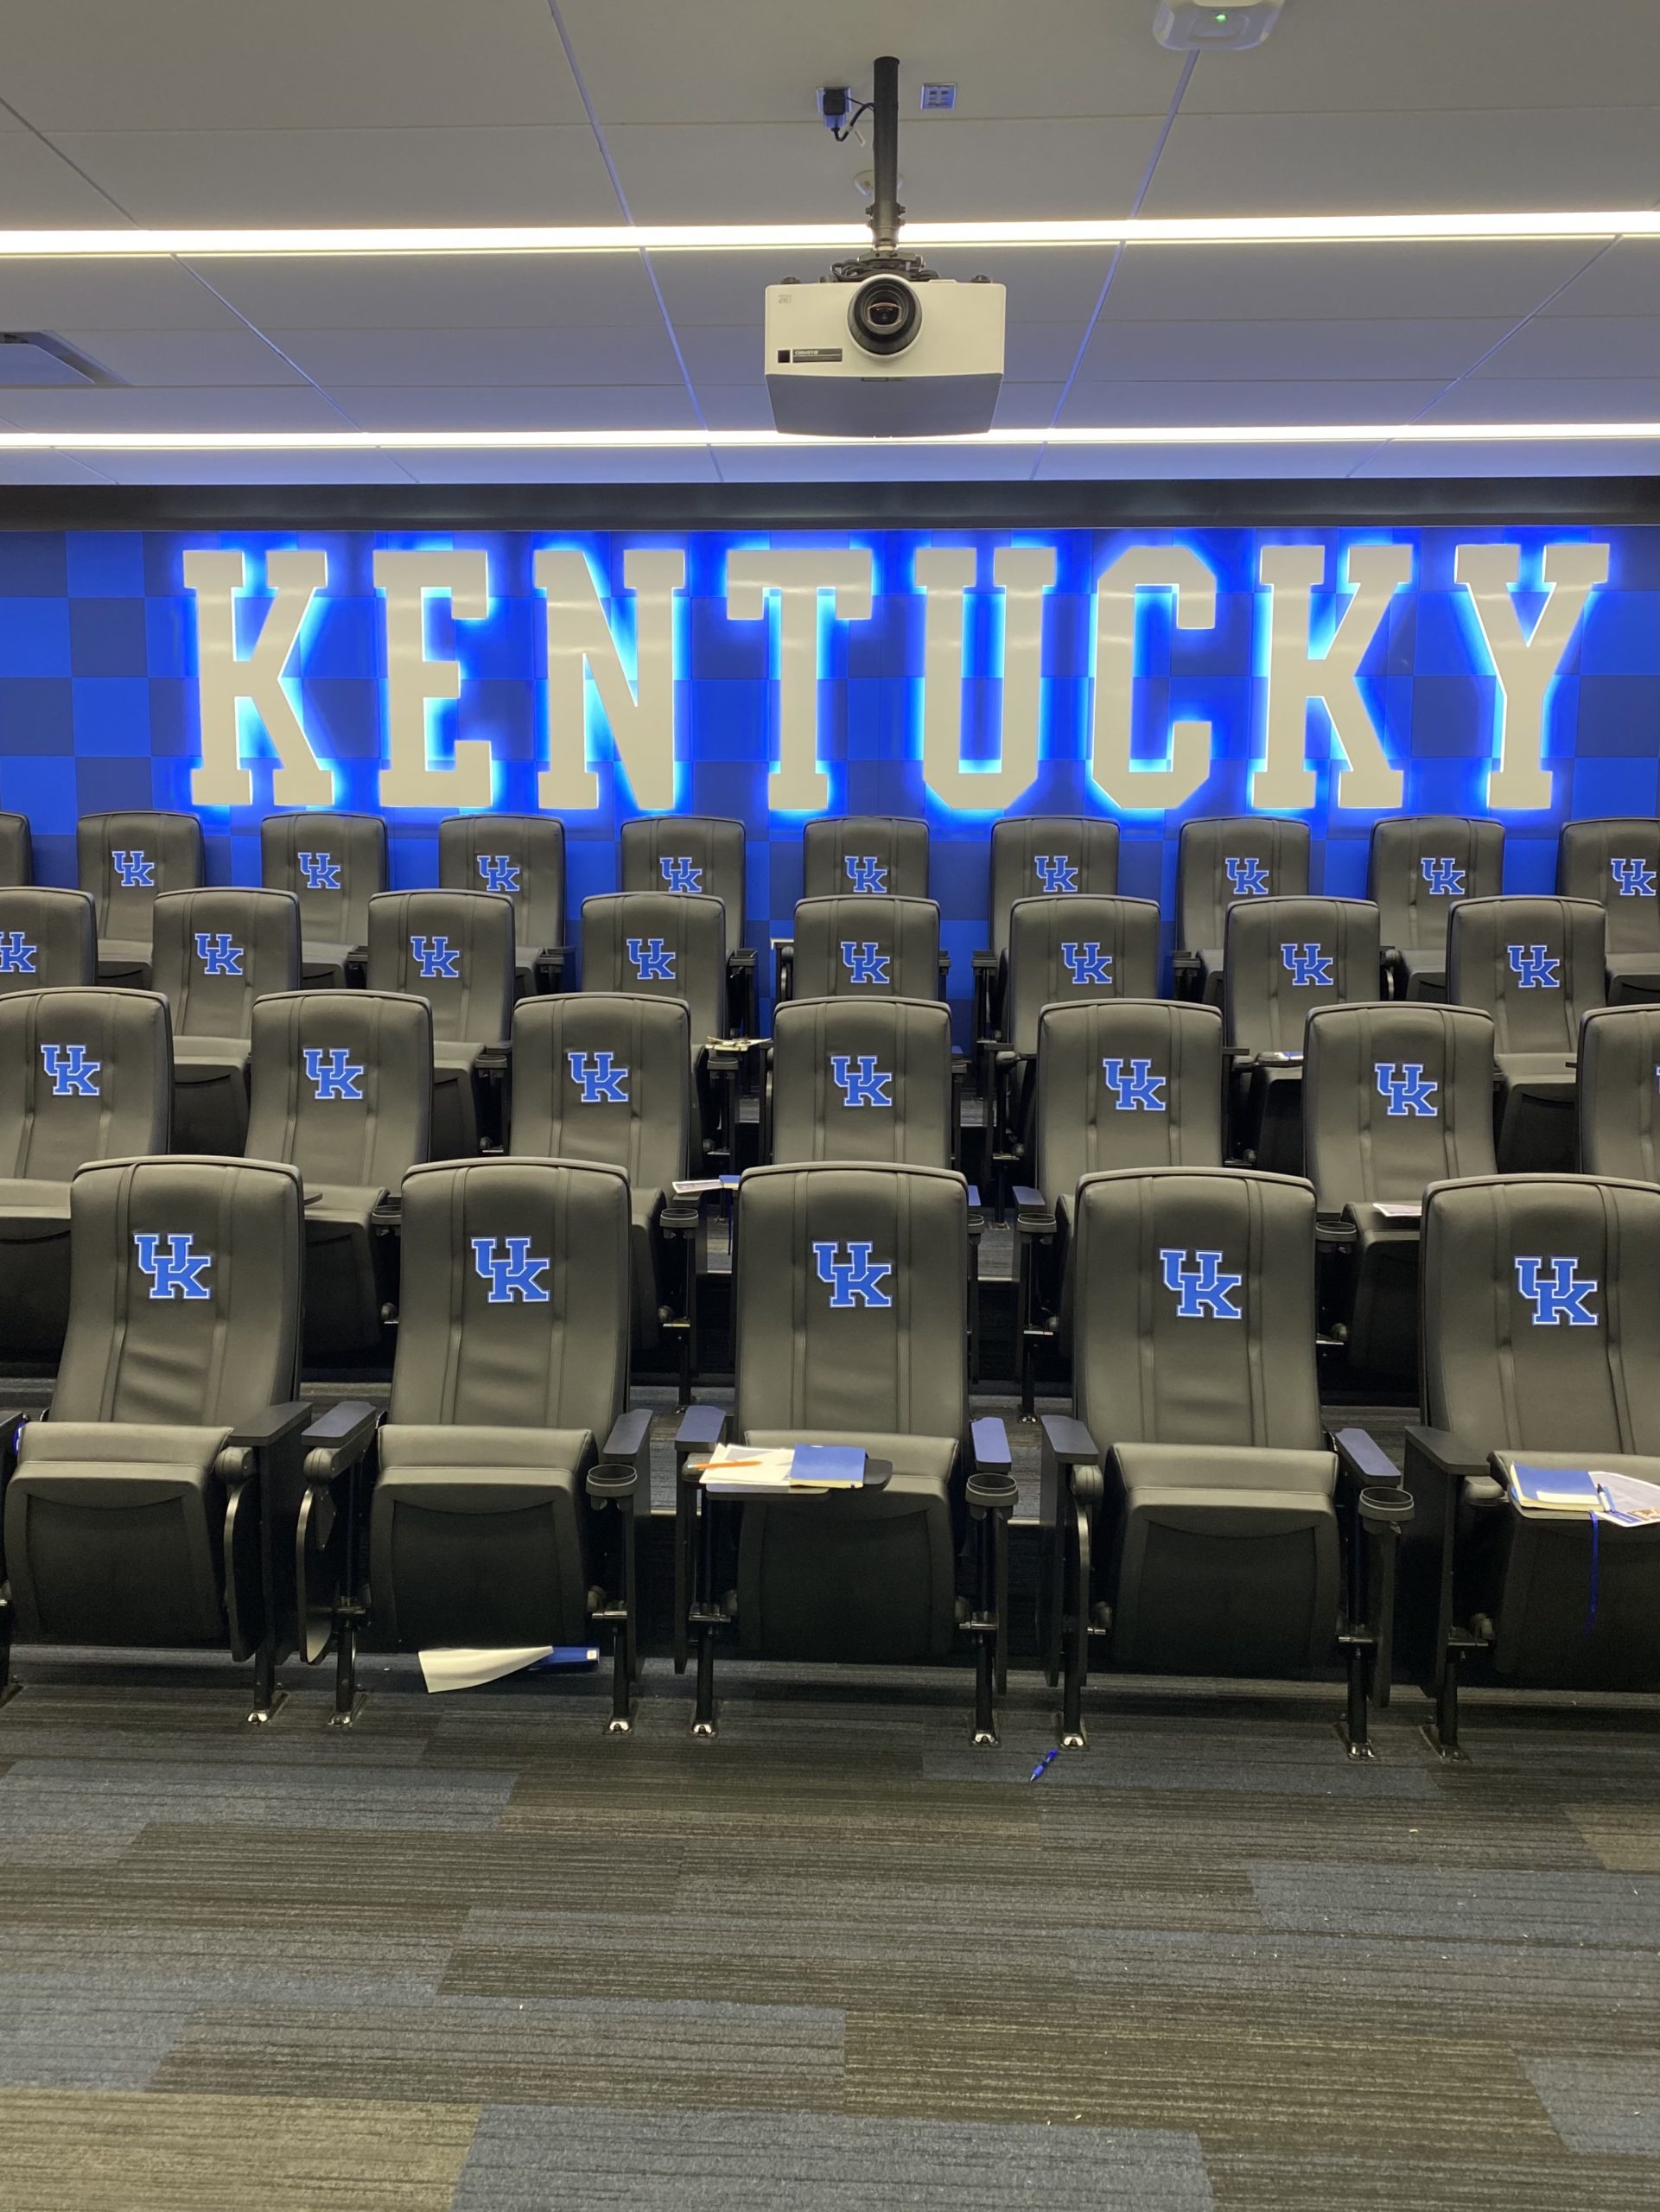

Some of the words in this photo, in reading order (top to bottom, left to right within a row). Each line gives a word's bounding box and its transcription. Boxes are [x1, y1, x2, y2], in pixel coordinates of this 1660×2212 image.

[182, 543, 1611, 811] KENTUCKY
[112, 850, 155, 887] UK
[298, 852, 340, 890] UK
[478, 855, 519, 892] UK
[659, 856, 703, 893] UK
[844, 855, 887, 893] UK
[1034, 855, 1078, 893] UK
[1224, 857, 1269, 895] UK
[1421, 857, 1465, 895] UK
[1610, 858, 1656, 896] UK
[194, 932, 244, 976] UK
[410, 936, 460, 978] UK
[626, 938, 676, 980] UK
[841, 941, 890, 984] UK
[1061, 942, 1112, 984] UK
[1281, 943, 1333, 986] UK
[1507, 944, 1560, 988] UK
[41, 1045, 99, 1096] UK
[303, 1049, 363, 1099] UK
[568, 1052, 628, 1103] UK
[831, 1056, 892, 1107] UK
[1103, 1058, 1166, 1111] UK
[1375, 1063, 1437, 1116] UK
[133, 1232, 213, 1300] UK
[470, 1236, 551, 1304] UK
[811, 1241, 894, 1309] UK
[1159, 1248, 1243, 1320] UK
[1514, 1256, 1599, 1326] UK
